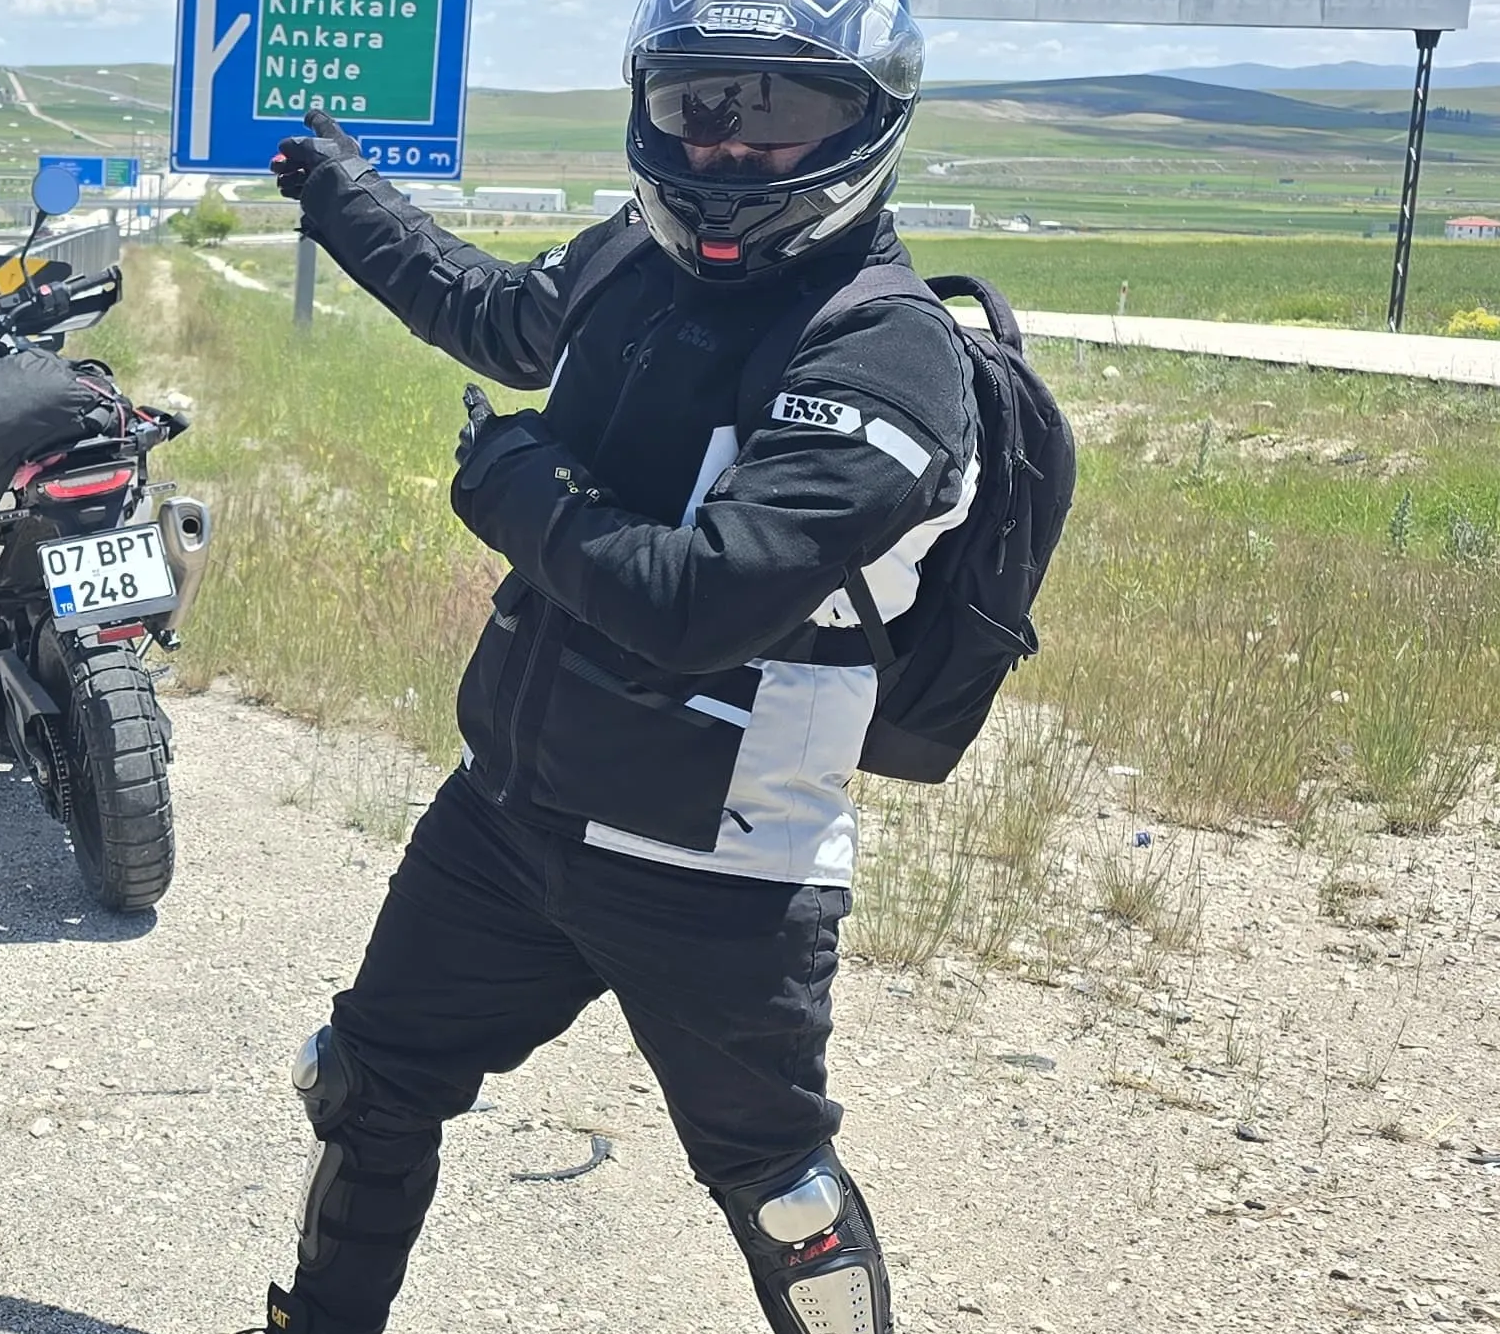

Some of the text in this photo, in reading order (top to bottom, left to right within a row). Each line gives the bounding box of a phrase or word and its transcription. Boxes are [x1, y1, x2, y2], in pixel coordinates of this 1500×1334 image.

[268, 24, 383, 49] Ankara
[266, 55, 361, 84] Niğde
[264, 87, 367, 112] Adana
[368, 147, 451, 167] 250 m
[96, 532, 154, 567] BPT
[79, 572, 139, 607] 248
[60, 601, 74, 612] TR
[271, 1305, 290, 1329] CAT
